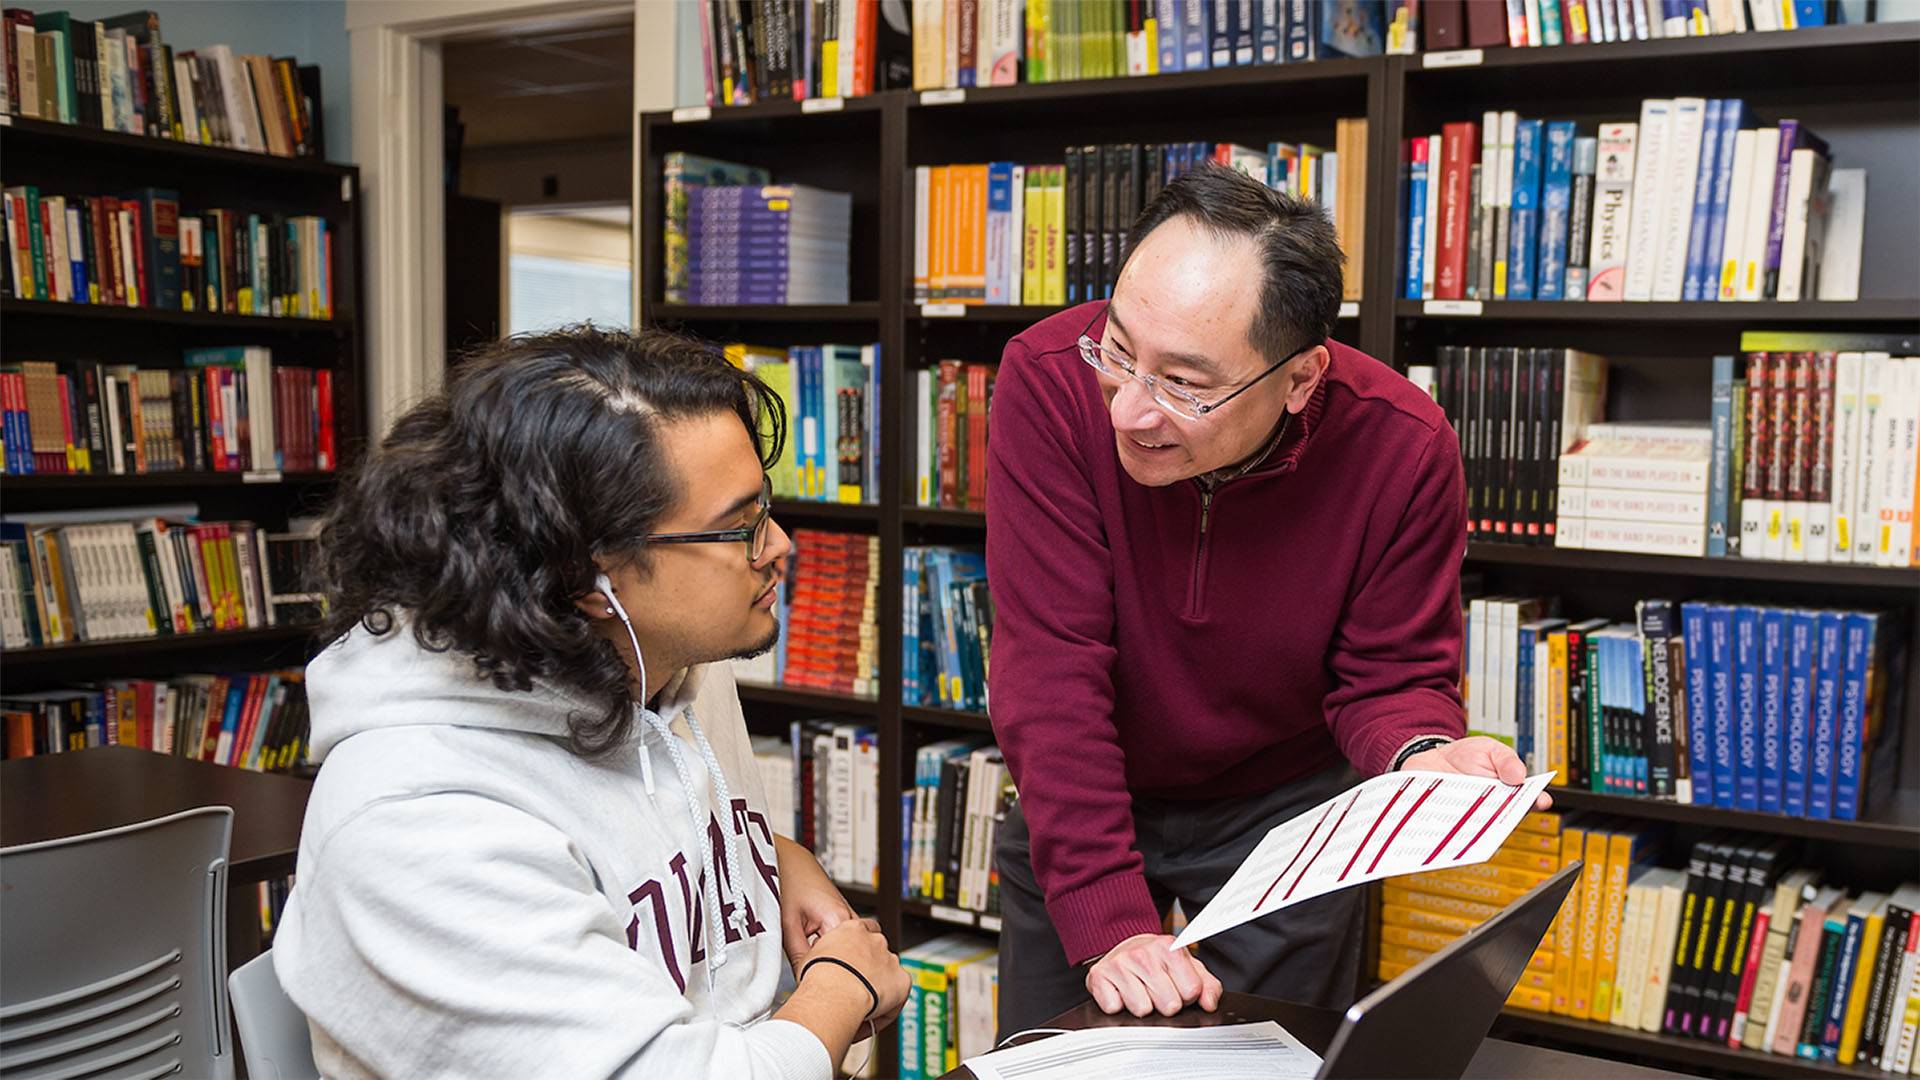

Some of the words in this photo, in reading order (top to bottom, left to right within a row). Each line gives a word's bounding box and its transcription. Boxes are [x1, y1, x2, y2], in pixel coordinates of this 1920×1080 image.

[1027, 224, 1038, 270] Java
[1047, 224, 1058, 270] Java
[1601, 189, 1624, 260] Physics
[1591, 499, 1605, 509] AND
[1609, 500, 1621, 509] THE
[1624, 500, 1644, 511] BAND
[1646, 502, 1675, 513] PLAYED
[1678, 503, 1689, 513] ON
[1592, 467, 1607, 477] AND
[1611, 468, 1623, 478] THE
[1626, 468, 1646, 480] BAND
[1650, 470, 1678, 481] PLAYED
[1680, 472, 1691, 482] ON
[1589, 530, 1604, 540] AND
[1608, 530, 1621, 540] THE
[1624, 531, 1643, 542] BAND
[1646, 533, 1675, 544] PLAYED
[1678, 534, 1688, 545] ON
[1653, 637, 1672, 744] NEUROSCIENCE
[1690, 667, 1706, 763] PSYCHOLOGY
[1713, 672, 1730, 768] PSYCHOLOGY
[1738, 672, 1754, 769] PSYCHOLOGY
[1764, 674, 1779, 771] PSYCHOLOGY
[1789, 677, 1806, 774] PSYCHOLOGY
[1815, 679, 1833, 777] PSYCHOLOGY
[1840, 680, 1860, 778] PSYCHOLOGY
[1410, 875, 1499, 897] PSYCHOLOGY
[1584, 864, 1601, 960] PSYCHOLOGY
[1604, 864, 1624, 962] PSYCHOLOGY
[924, 992, 942, 1077] CALCULUS
